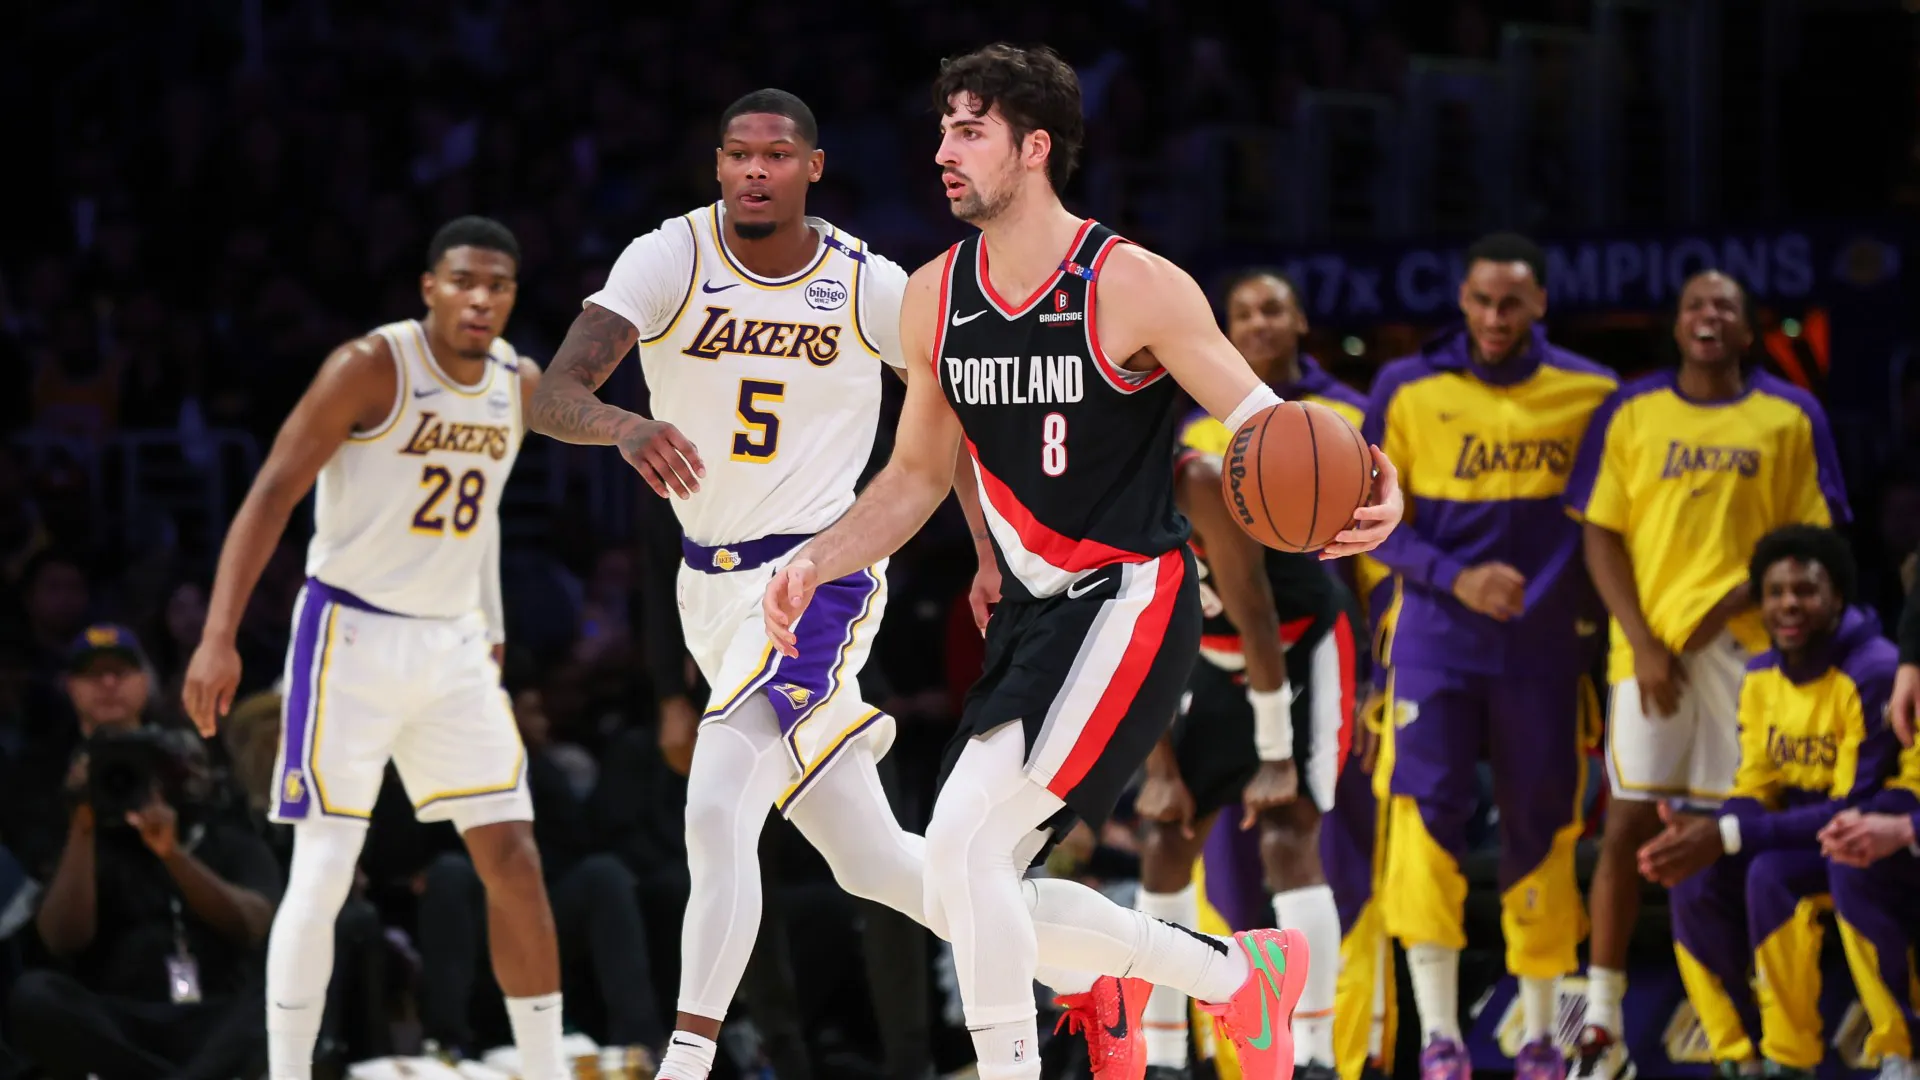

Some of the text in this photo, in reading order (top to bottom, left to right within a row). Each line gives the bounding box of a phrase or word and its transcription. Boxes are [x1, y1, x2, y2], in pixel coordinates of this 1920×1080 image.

[809, 286, 845, 303] bibigo
[1394, 230, 1815, 314] CMPIONS
[681, 304, 842, 368] LAKERS
[1039, 311, 1083, 323] BRIGHTSIDE
[945, 355, 1084, 405] PORTLAND
[398, 411, 510, 460] LAKERS
[730, 377, 787, 465] 5
[1041, 412, 1068, 477] 8
[1229, 424, 1257, 526] Wilson
[1453, 434, 1573, 480] LAKERS
[1661, 440, 1761, 479] LAKERS
[410, 464, 486, 538] 28
